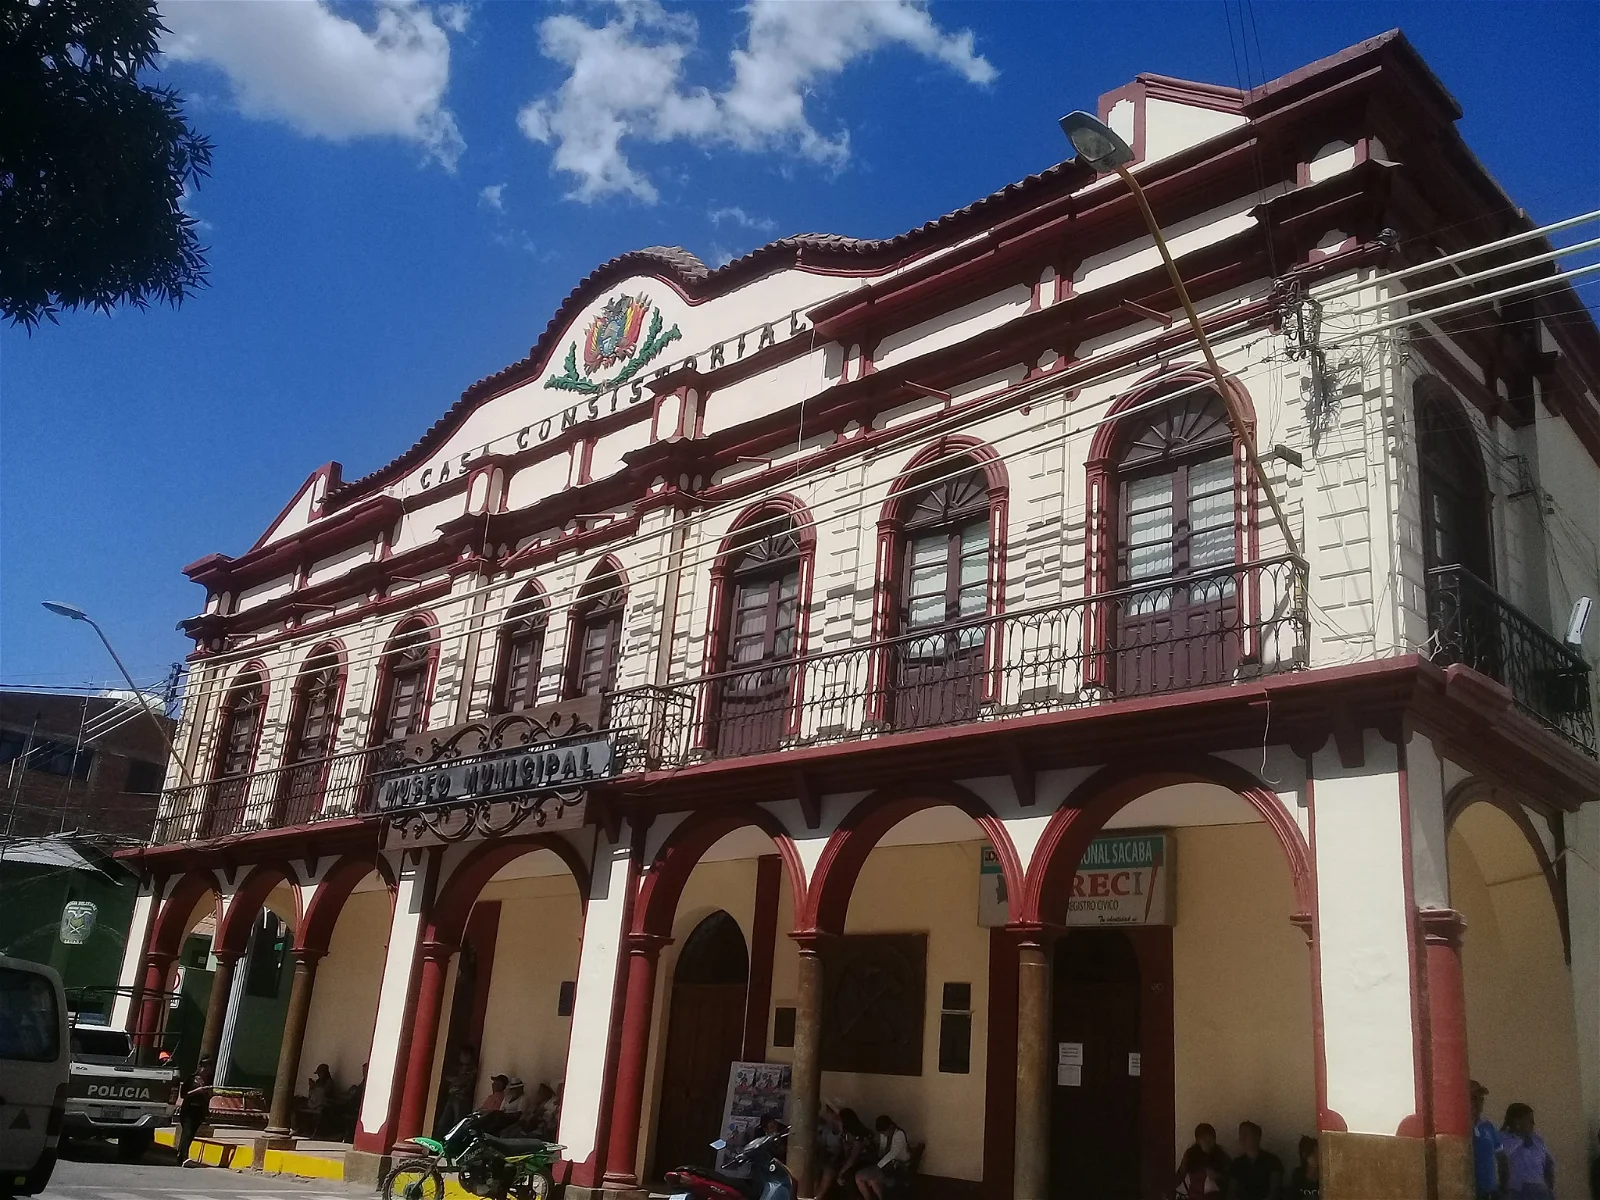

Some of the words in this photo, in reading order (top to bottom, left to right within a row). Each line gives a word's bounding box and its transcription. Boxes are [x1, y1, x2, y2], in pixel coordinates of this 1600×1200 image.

[385, 773, 450, 804] MUSEO
[464, 746, 593, 795] MUNICIPAL
[1112, 840, 1153, 864] SACABA
[1068, 900, 1096, 911] EGISTRO
[87, 1085, 151, 1099] POLICIA
